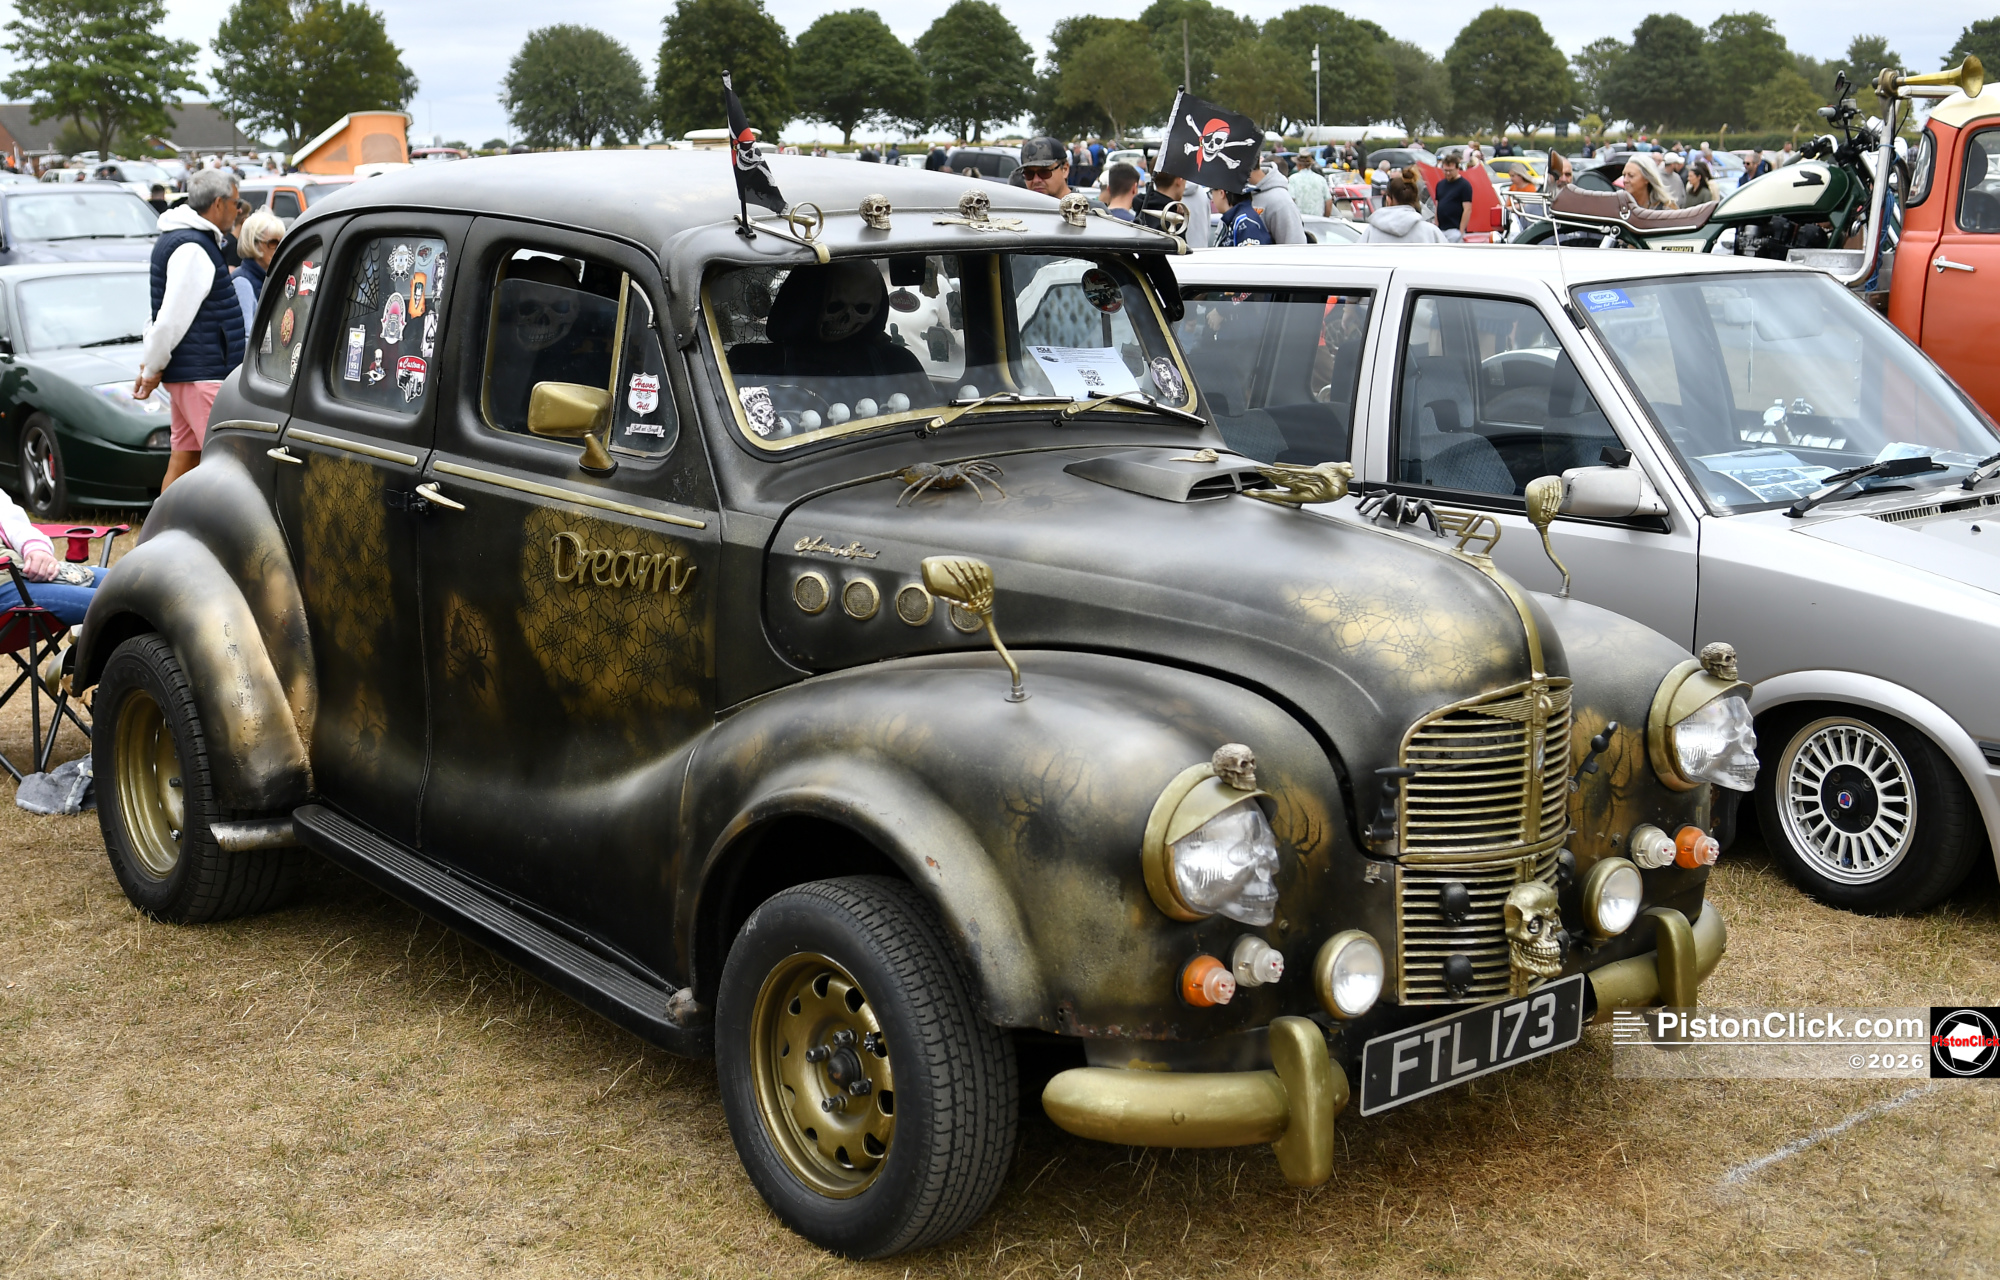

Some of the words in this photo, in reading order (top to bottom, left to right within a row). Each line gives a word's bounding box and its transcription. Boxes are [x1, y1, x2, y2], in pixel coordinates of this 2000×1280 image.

[348, 361, 359, 370] 1951
[634, 377, 656, 389] Havoc
[636, 401, 650, 411] Hill
[549, 531, 697, 595] Dream
[1390, 1022, 1477, 1097] FTL
[1489, 992, 1556, 1063] 173
